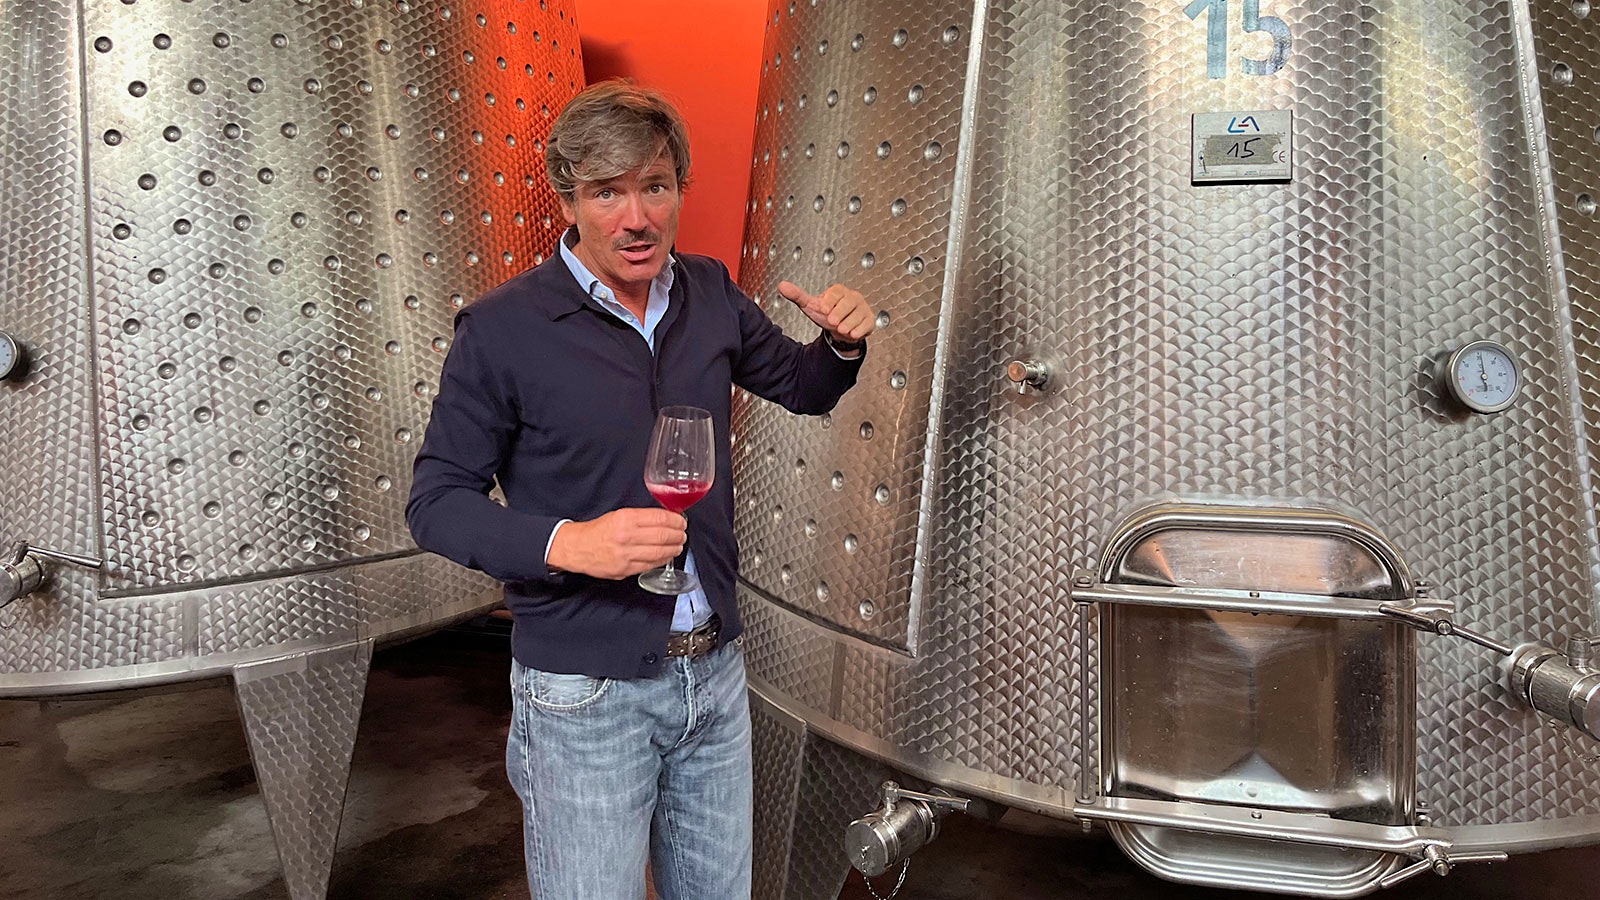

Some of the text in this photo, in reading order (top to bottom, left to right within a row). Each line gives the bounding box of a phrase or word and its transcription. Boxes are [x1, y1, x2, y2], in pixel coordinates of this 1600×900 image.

[1183, 0, 1292, 79] 15
[1226, 137, 1262, 159] 15
[1271, 150, 1286, 163] CE
